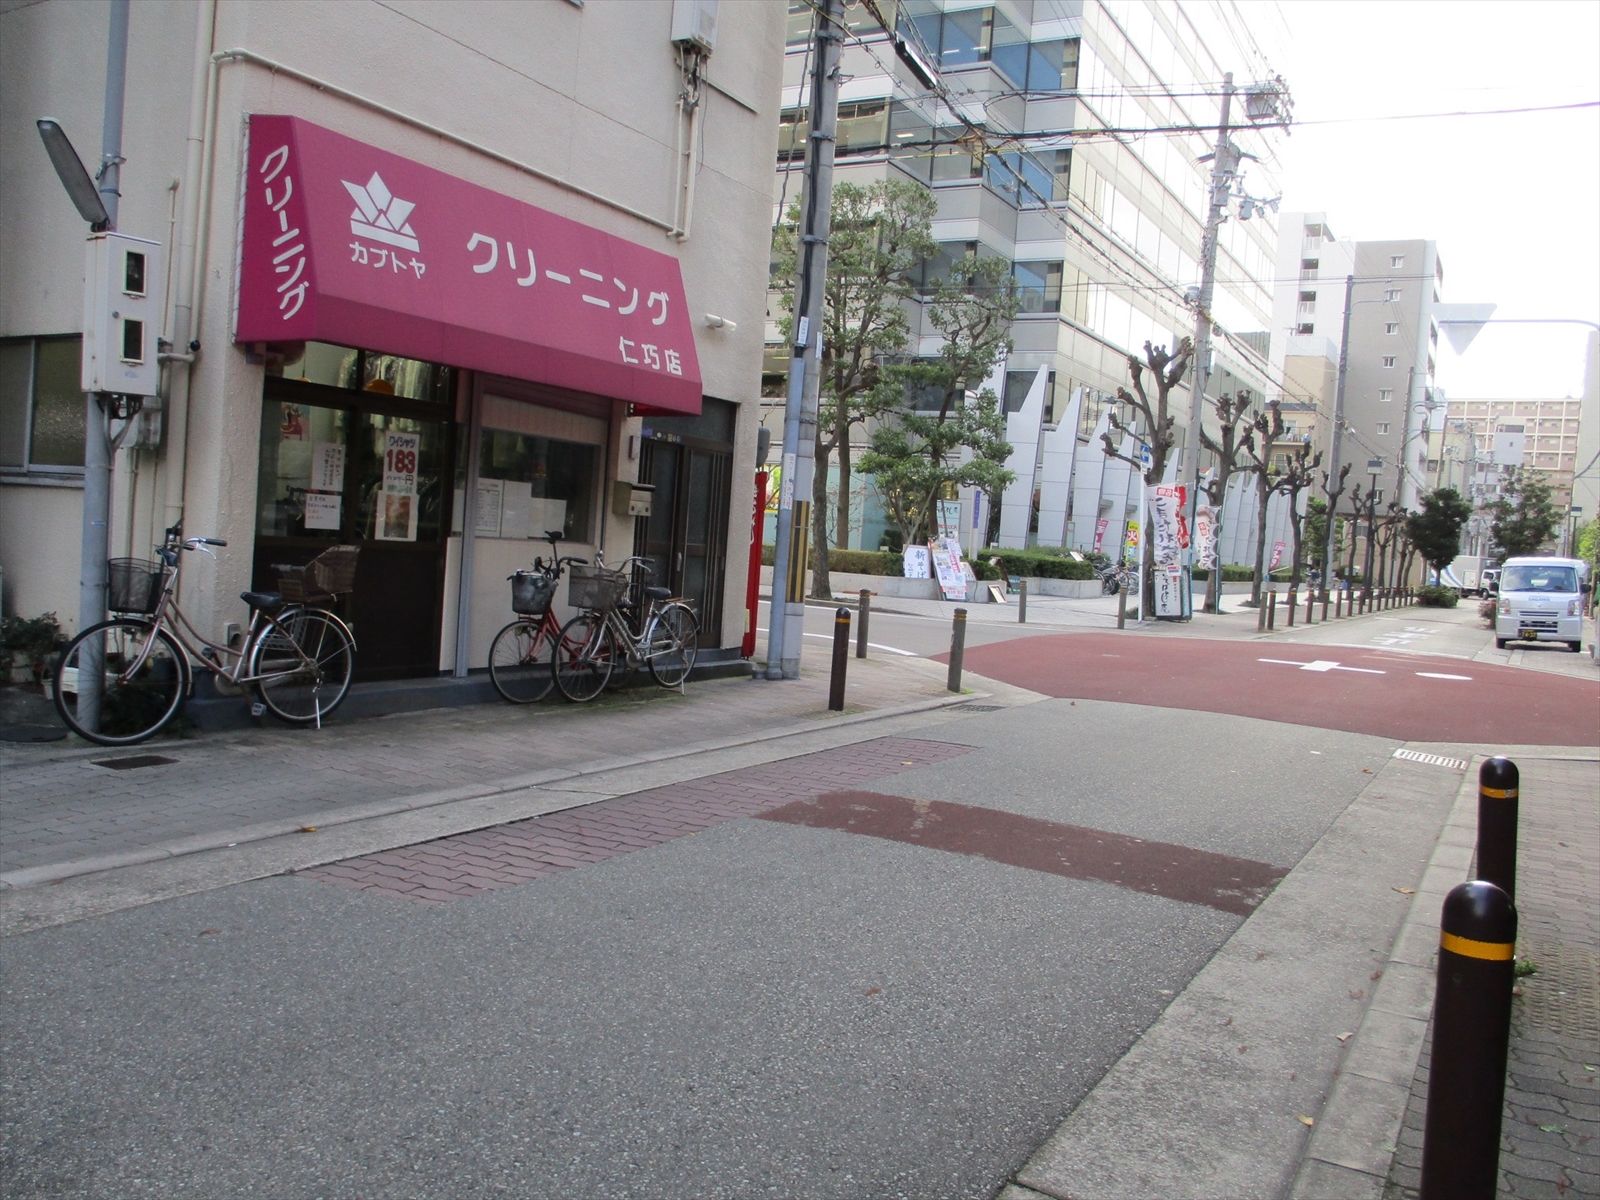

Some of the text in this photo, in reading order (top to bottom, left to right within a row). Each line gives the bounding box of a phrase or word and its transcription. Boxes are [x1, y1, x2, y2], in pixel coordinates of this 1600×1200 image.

[260, 144, 310, 320] クリーニング
[349, 241, 426, 280] カブトヤ
[466, 232, 670, 327] クリーニング
[619, 335, 683, 377] 仁巧店
[386, 449, 416, 474] 183
